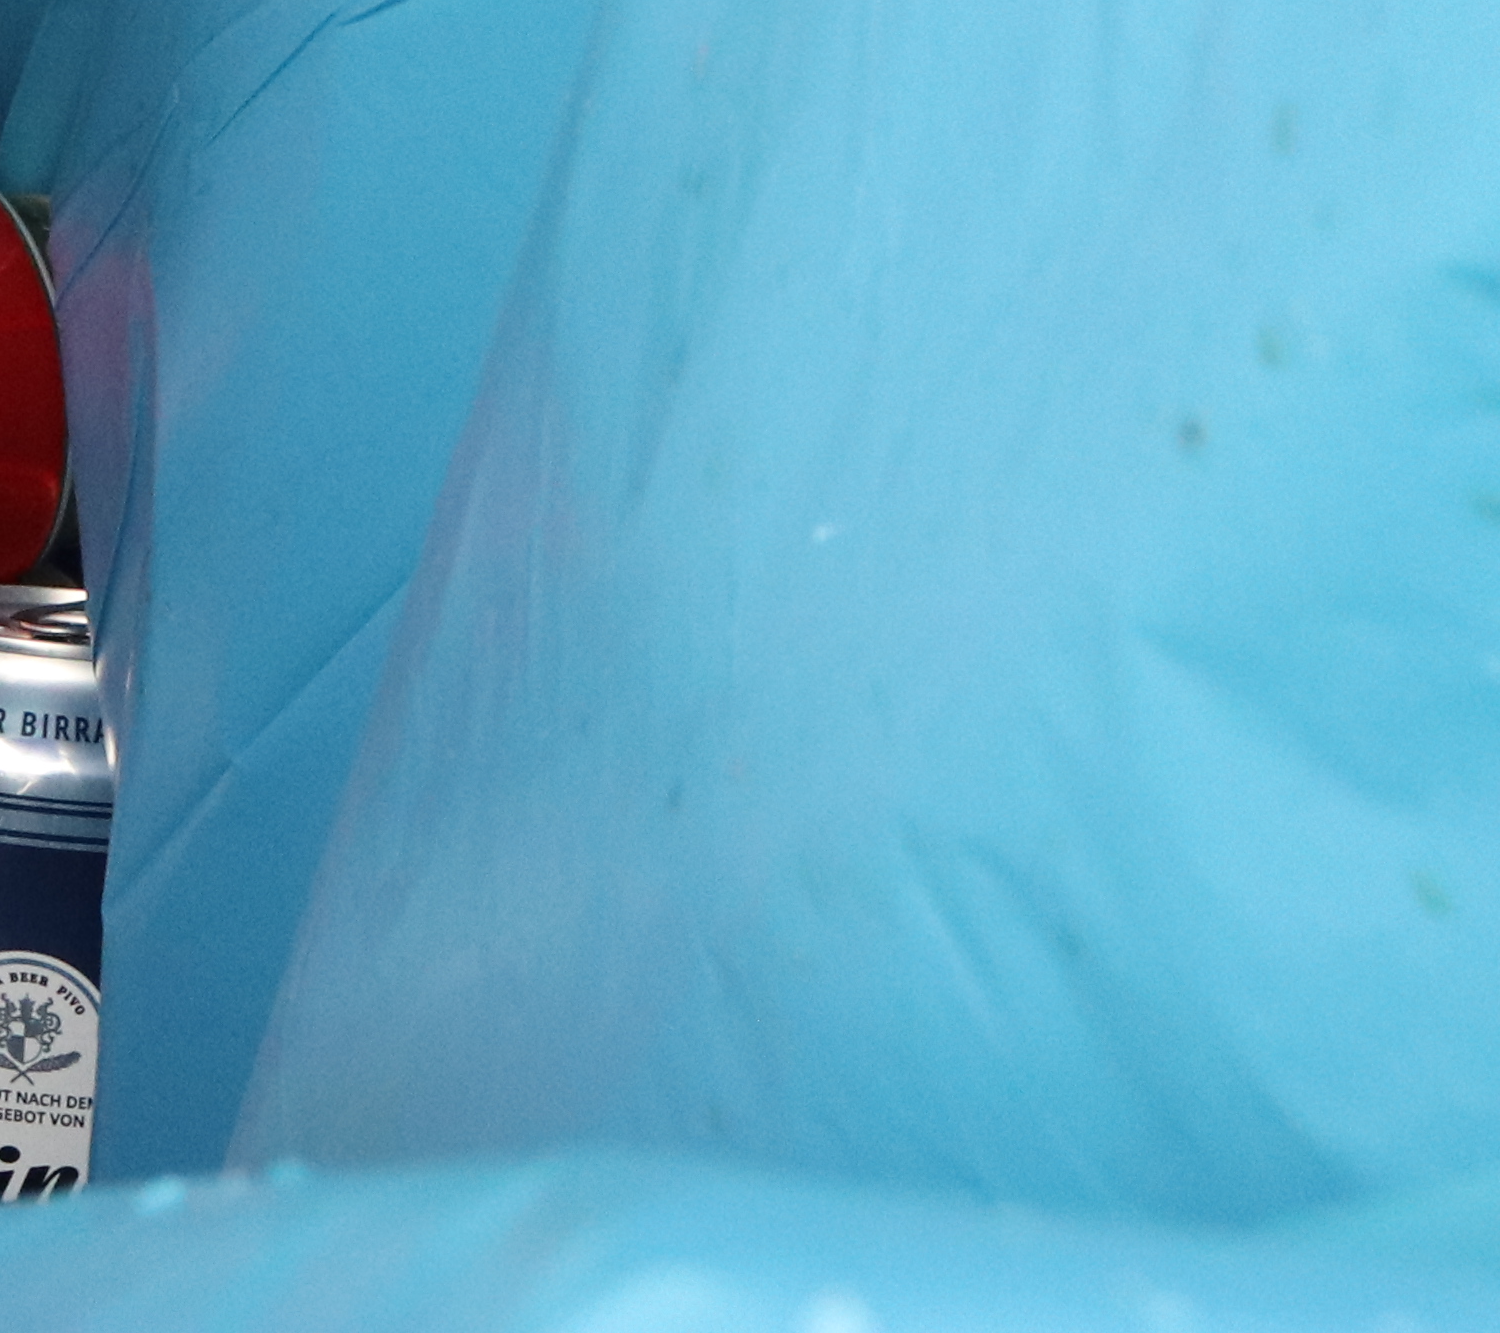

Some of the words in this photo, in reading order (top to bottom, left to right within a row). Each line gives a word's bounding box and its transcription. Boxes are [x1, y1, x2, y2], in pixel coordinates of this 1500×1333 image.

[9, 970, 50, 989] BEER
[55, 983, 87, 1019] PIVO
[16, 1087, 62, 1109] NACH
[34, 1110, 86, 1129] VON
